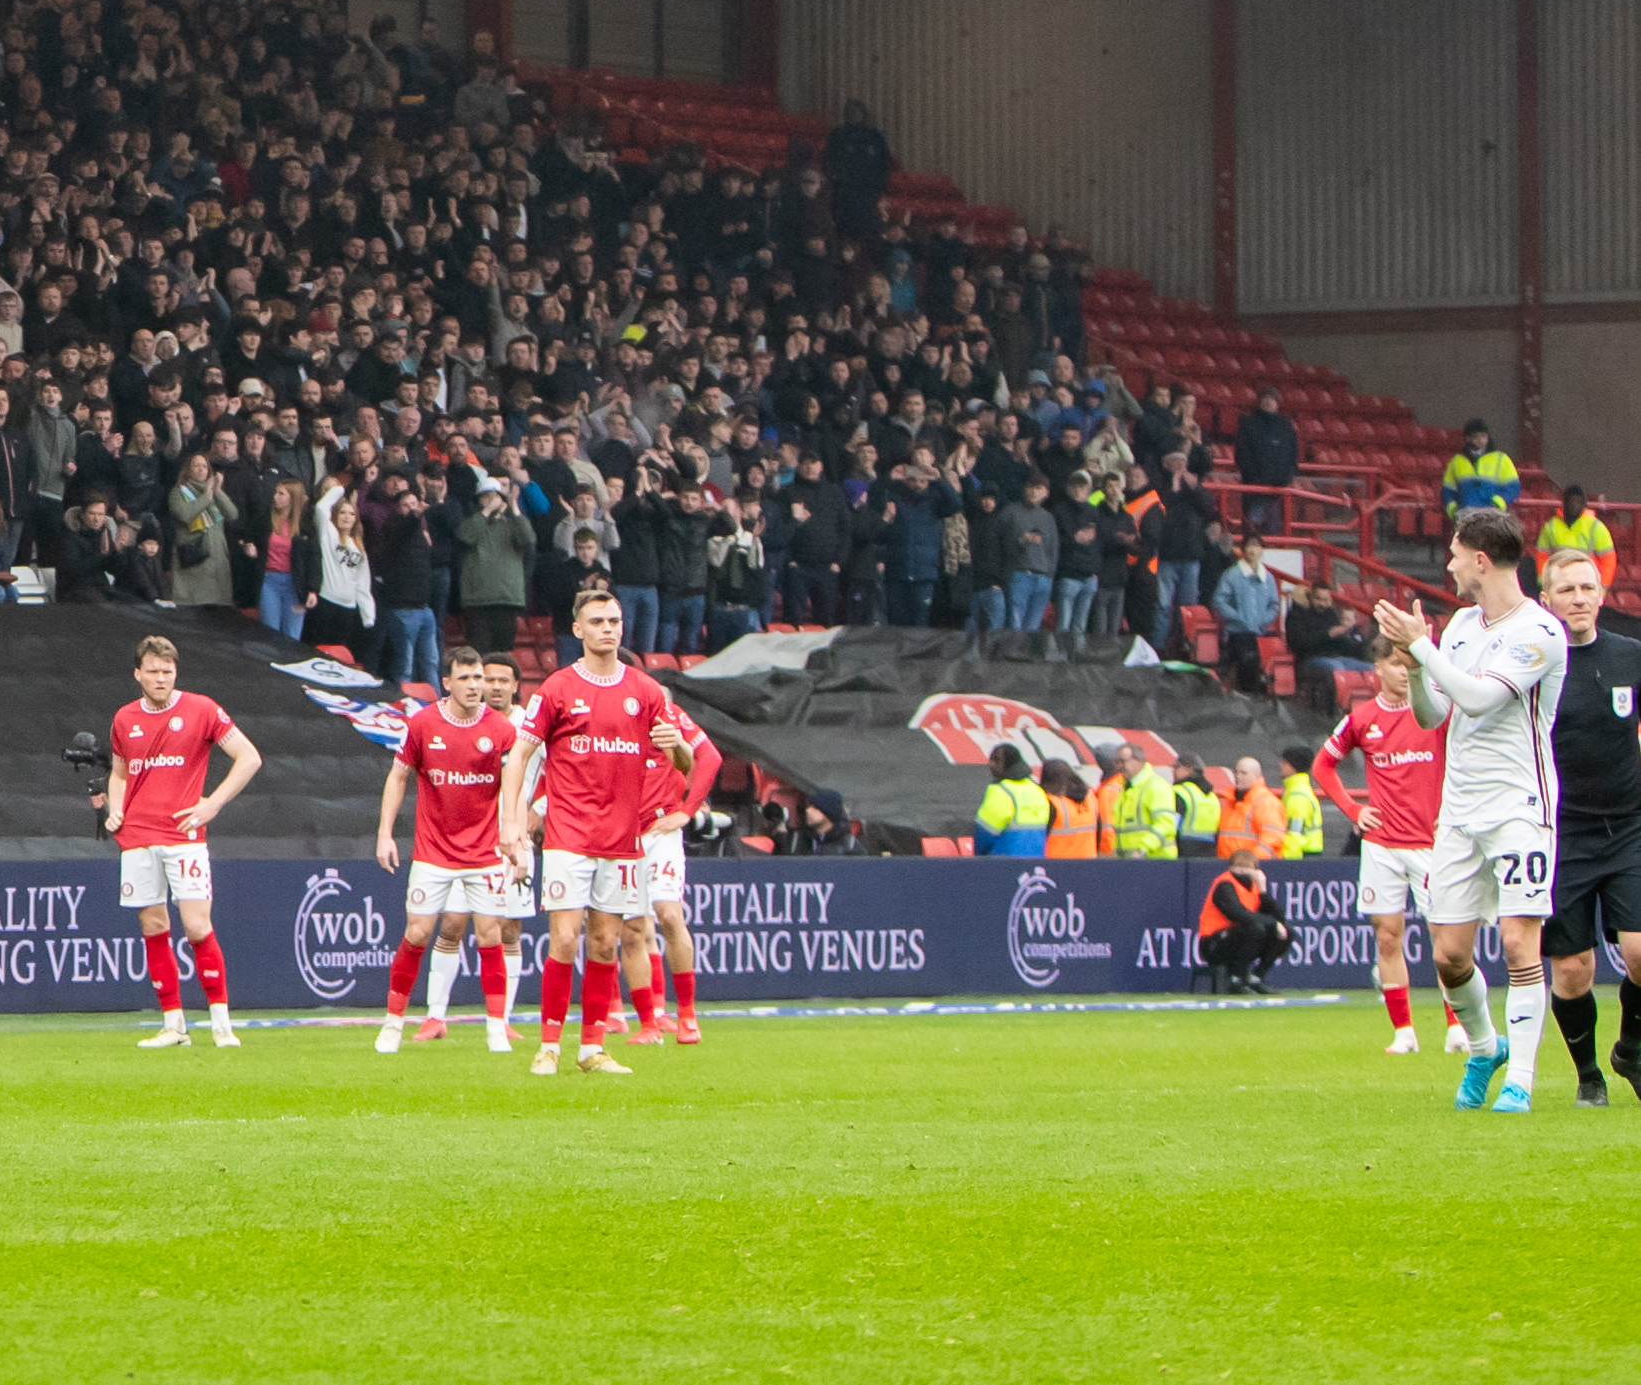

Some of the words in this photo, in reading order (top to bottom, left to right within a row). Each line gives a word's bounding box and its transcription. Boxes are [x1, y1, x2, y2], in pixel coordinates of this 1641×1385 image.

[1390, 750, 1434, 765] Huboo
[448, 771, 495, 786] Huboo
[178, 859, 202, 879] 16
[1502, 851, 1548, 886] 20
[311, 895, 386, 947] wob
[682, 881, 835, 926] SPITALITY
[1021, 892, 1086, 939] wob
[45, 936, 196, 983] VENUS
[313, 944, 396, 974] competiti
[798, 927, 926, 973] VENUES
[1022, 936, 1112, 965] competitions
[1135, 927, 1177, 968] AT
